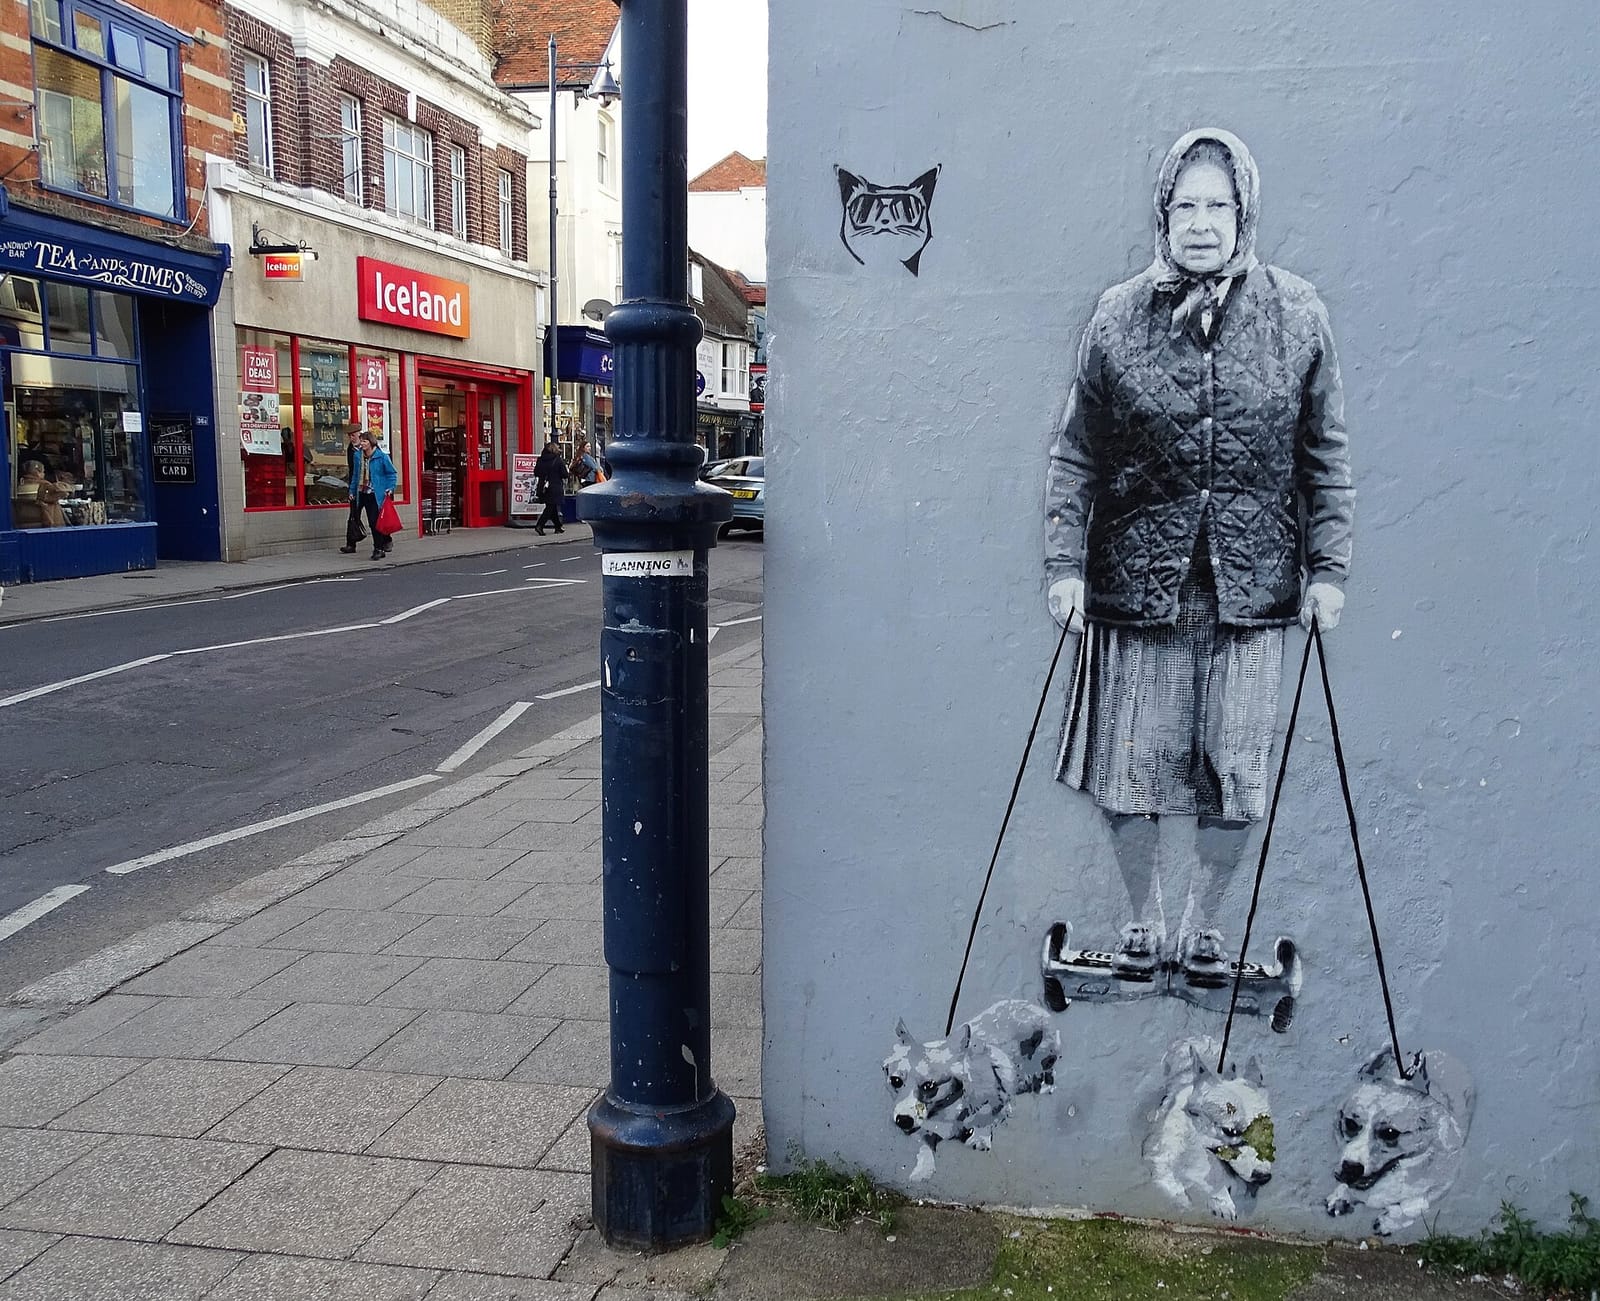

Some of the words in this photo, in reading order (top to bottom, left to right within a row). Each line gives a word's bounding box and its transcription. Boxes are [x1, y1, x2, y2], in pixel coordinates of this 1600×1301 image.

[0, 240, 33, 253] SANDWICH
[8, 249, 25, 258] BAR
[33, 241, 79, 271] TEA
[90, 258, 118, 271] AND
[129, 261, 185, 295] TIMES
[266, 260, 300, 272] Iceland
[375, 271, 462, 327] Iceland
[250, 356, 255, 367] 7
[255, 357, 270, 368] DAY
[249, 367, 272, 379] DEALS
[367, 367, 383, 391] £1
[153, 445, 192, 455] UPSTAIRS
[162, 465, 187, 476] CARD
